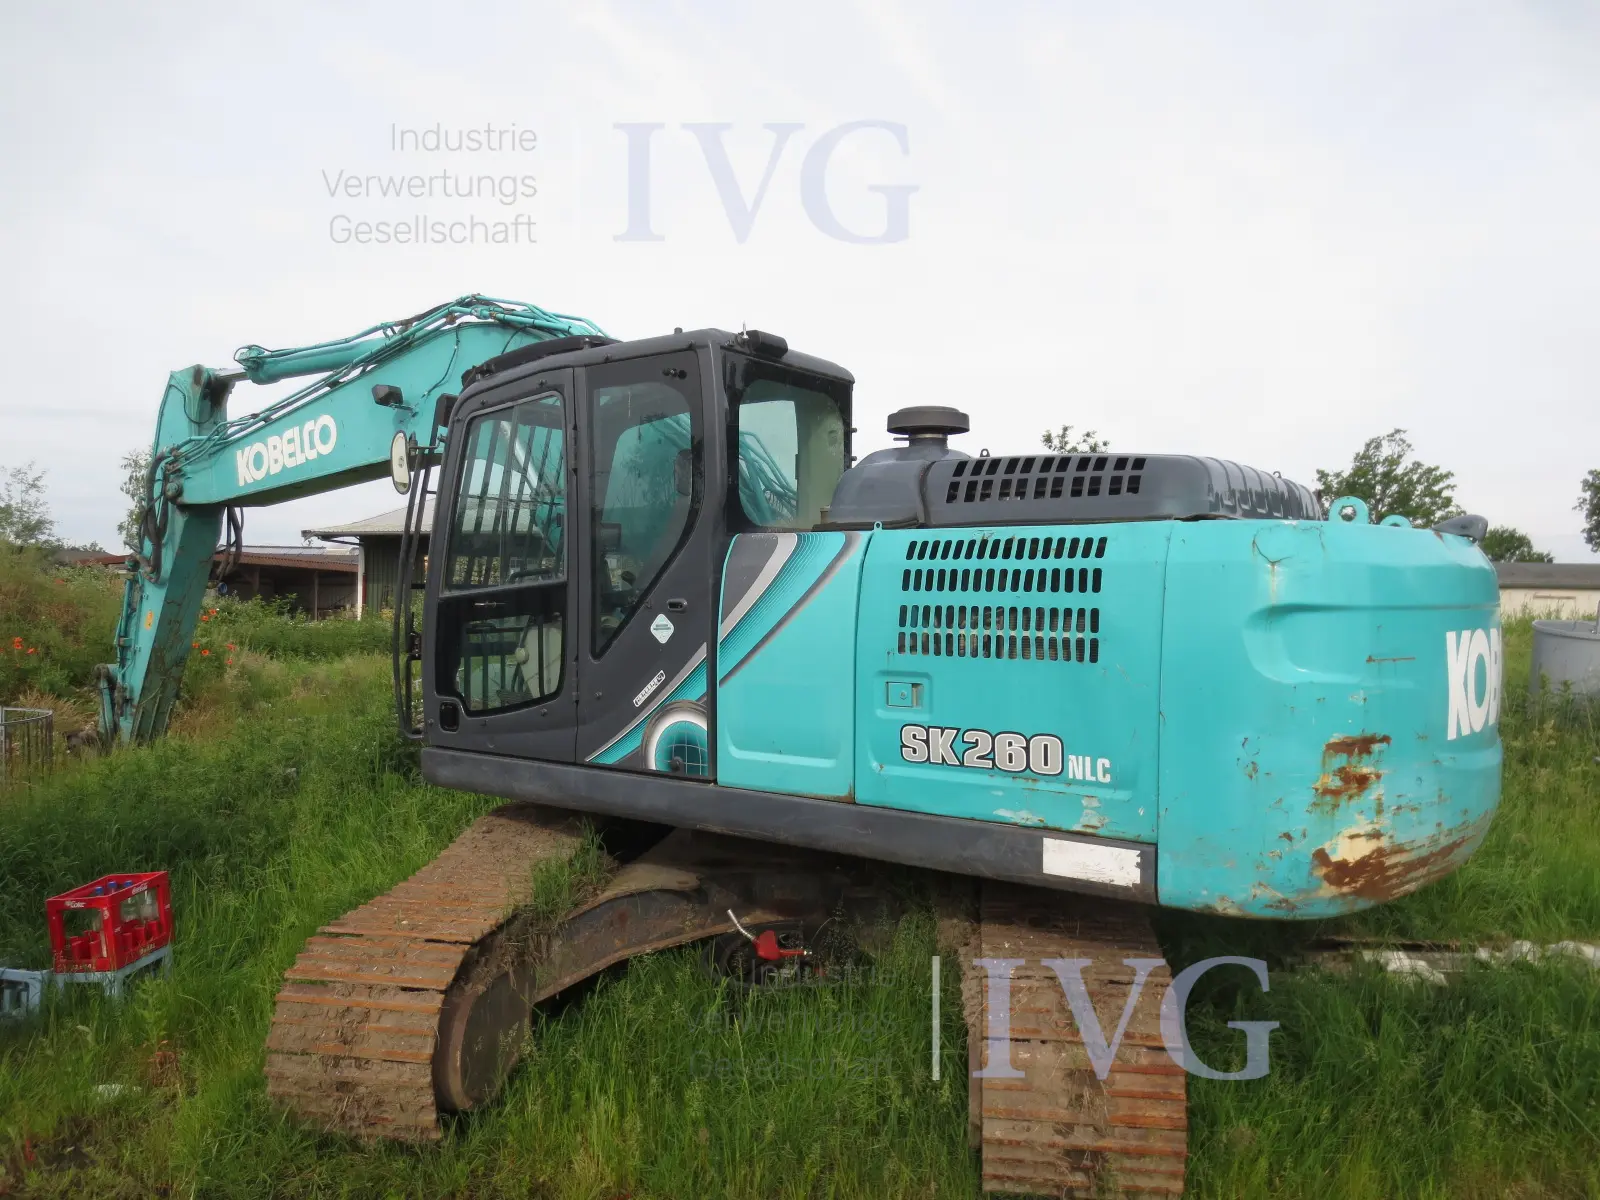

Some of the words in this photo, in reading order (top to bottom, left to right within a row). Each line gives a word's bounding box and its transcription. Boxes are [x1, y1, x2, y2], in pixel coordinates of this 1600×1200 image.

[236, 414, 337, 487] KOBELCO
[900, 723, 1064, 776] SK260
[1068, 754, 1111, 784] NLC
